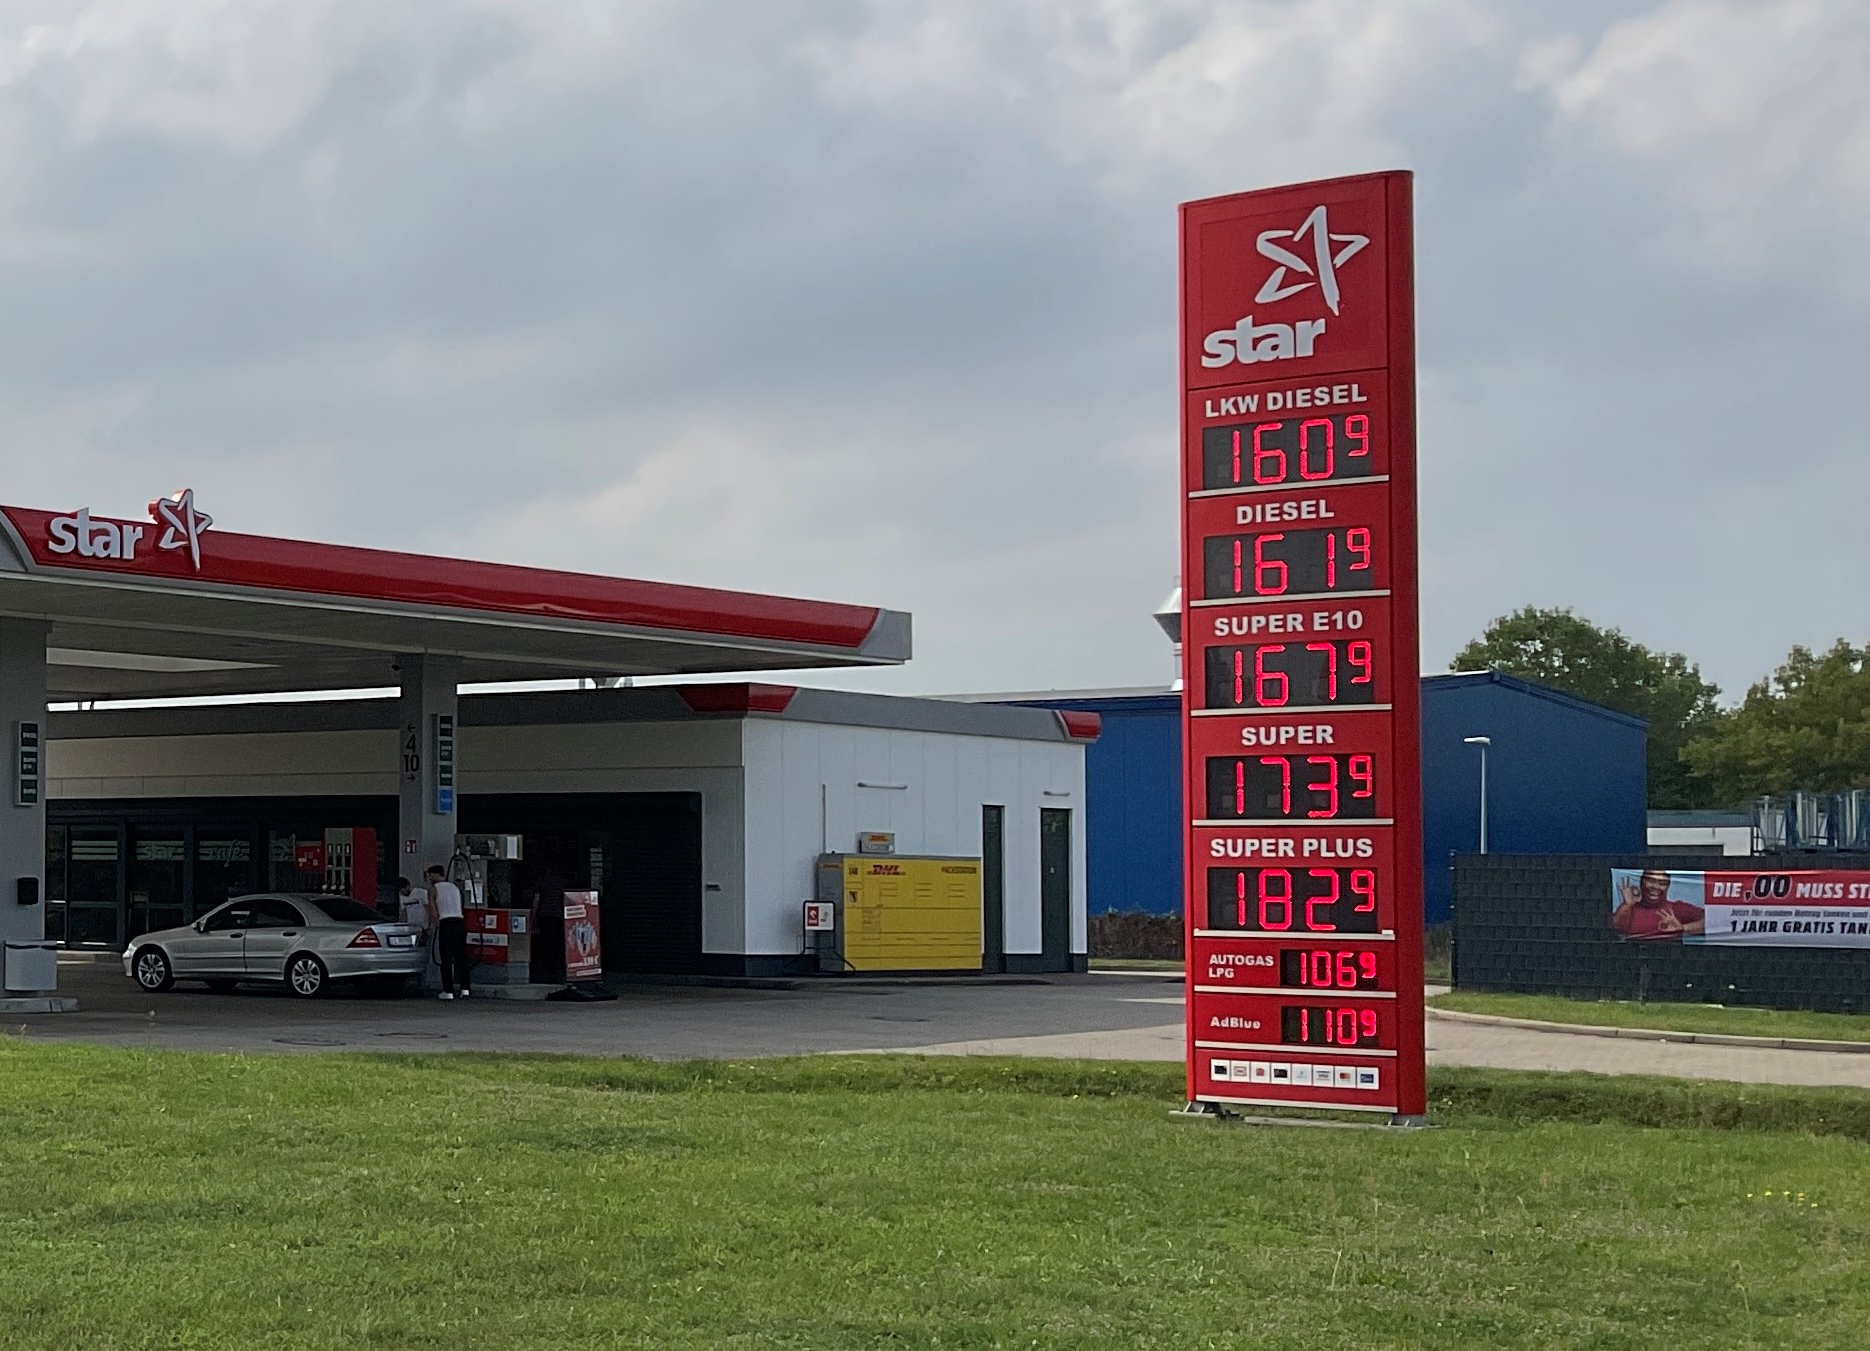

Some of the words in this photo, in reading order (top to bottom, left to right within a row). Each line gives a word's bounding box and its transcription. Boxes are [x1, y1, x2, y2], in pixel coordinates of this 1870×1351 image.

[1201, 315, 1326, 368] star
[1205, 394, 1259, 418] LKW
[1266, 383, 1368, 411] DIESEL
[1233, 414, 1369, 485] 1609
[1236, 499, 1335, 525] DIESEL
[48, 507, 143, 560] star
[1233, 527, 1371, 595] 1619
[1214, 613, 1304, 637] SUPER
[1312, 610, 1363, 631] E10
[1234, 640, 1372, 706] 1679
[406, 734, 417, 752] 4
[1241, 725, 1334, 746] SUPER
[403, 754, 420, 772] 10
[1236, 755, 1372, 818] 1739
[1210, 838, 1295, 858] SUPER
[1302, 838, 1373, 858] PLUS
[1237, 869, 1375, 931] 1829
[1713, 881, 1743, 898] DIE
[1795, 882, 1844, 899] MUSS
[1847, 883, 1870, 899] ST
[1730, 920, 1737, 933] 1
[1741, 920, 1778, 933] JAHR
[1782, 921, 1834, 934] GRATIS
[1840, 921, 1870, 934] TAN
[1208, 967, 1235, 979] LPG
[1209, 954, 1274, 967] AUTOGAS
[1300, 950, 1376, 988] 1069
[1210, 1016, 1261, 1029] AdBlue
[1300, 1008, 1377, 1045] 1109
